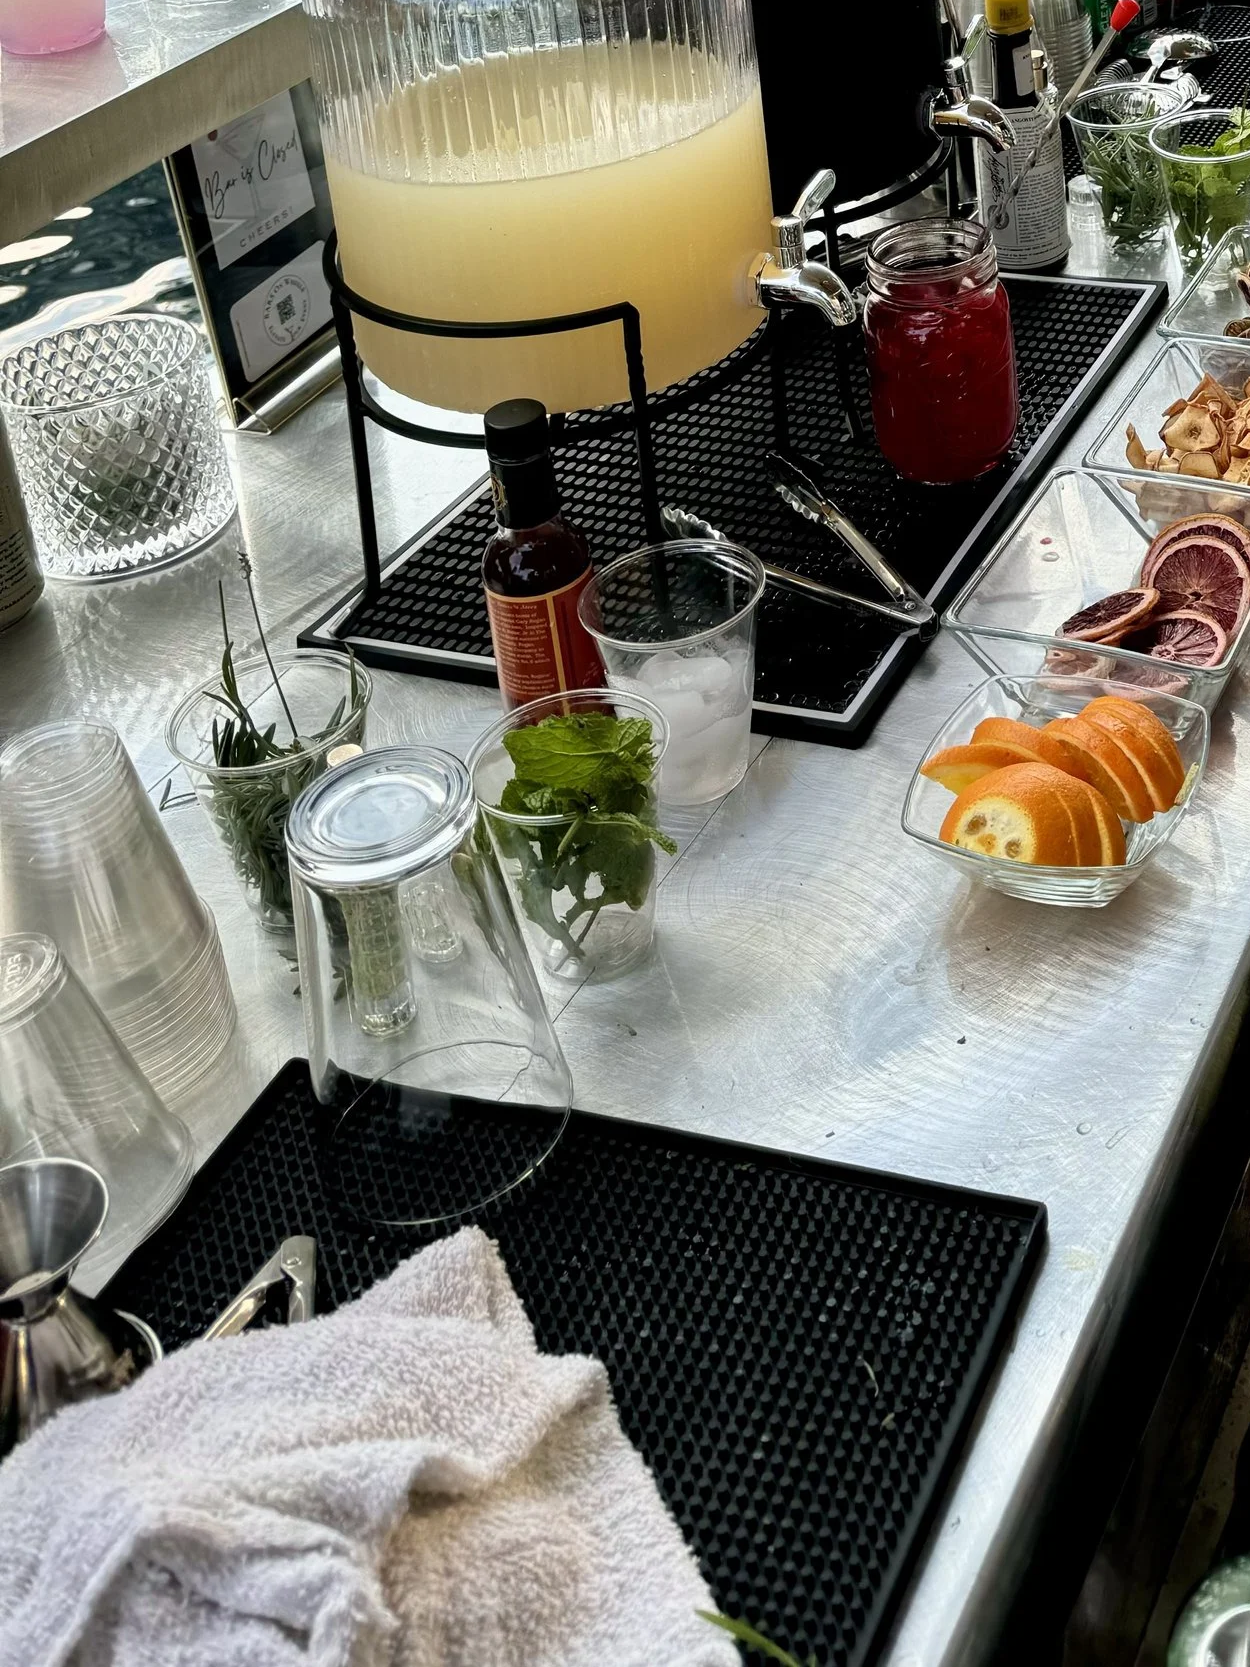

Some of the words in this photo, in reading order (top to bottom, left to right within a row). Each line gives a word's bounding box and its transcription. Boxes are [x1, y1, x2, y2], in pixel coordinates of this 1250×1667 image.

[204, 171, 238, 220] Bar
[240, 165, 254, 185] is
[258, 129, 298, 181] Closed
[240, 206, 294, 248] CHEERS!
